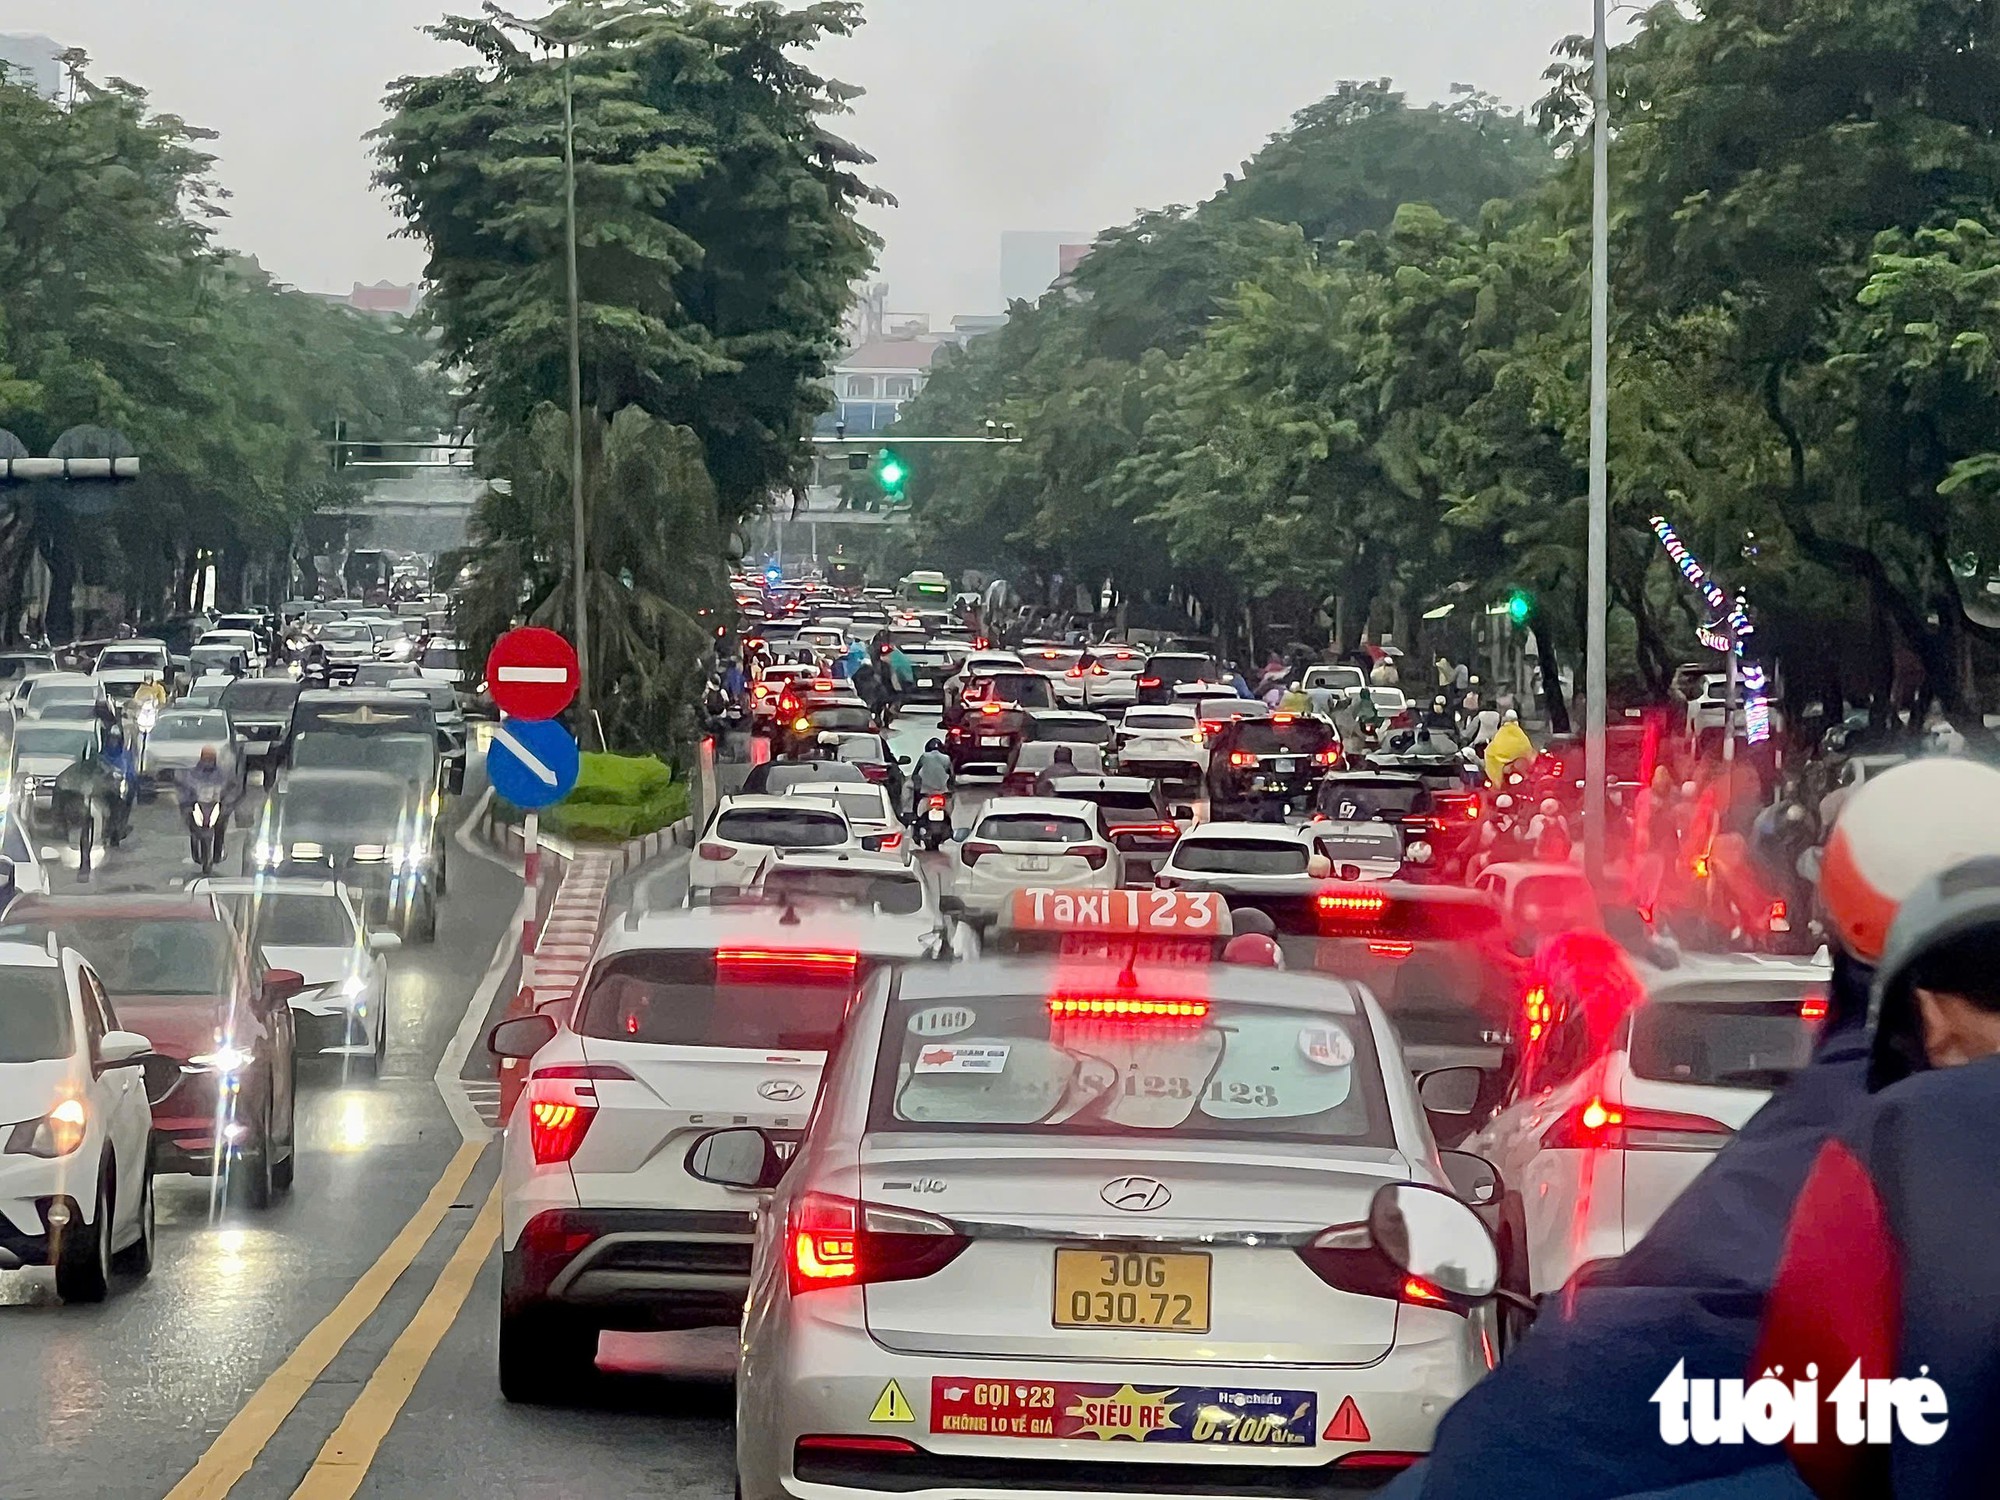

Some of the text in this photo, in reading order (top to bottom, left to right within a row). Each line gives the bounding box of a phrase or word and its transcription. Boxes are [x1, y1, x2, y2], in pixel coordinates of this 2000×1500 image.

[1025, 887, 1212, 928] Taxi 123
[1211, 1081, 1279, 1107] 123
[1100, 1254, 1165, 1287] 30G
[1071, 1290, 1192, 1325] 030.72
[974, 1384, 1010, 1410] GỌI
[991, 1417, 1008, 1433] LO
[1084, 1400, 1132, 1427] SIÊU
